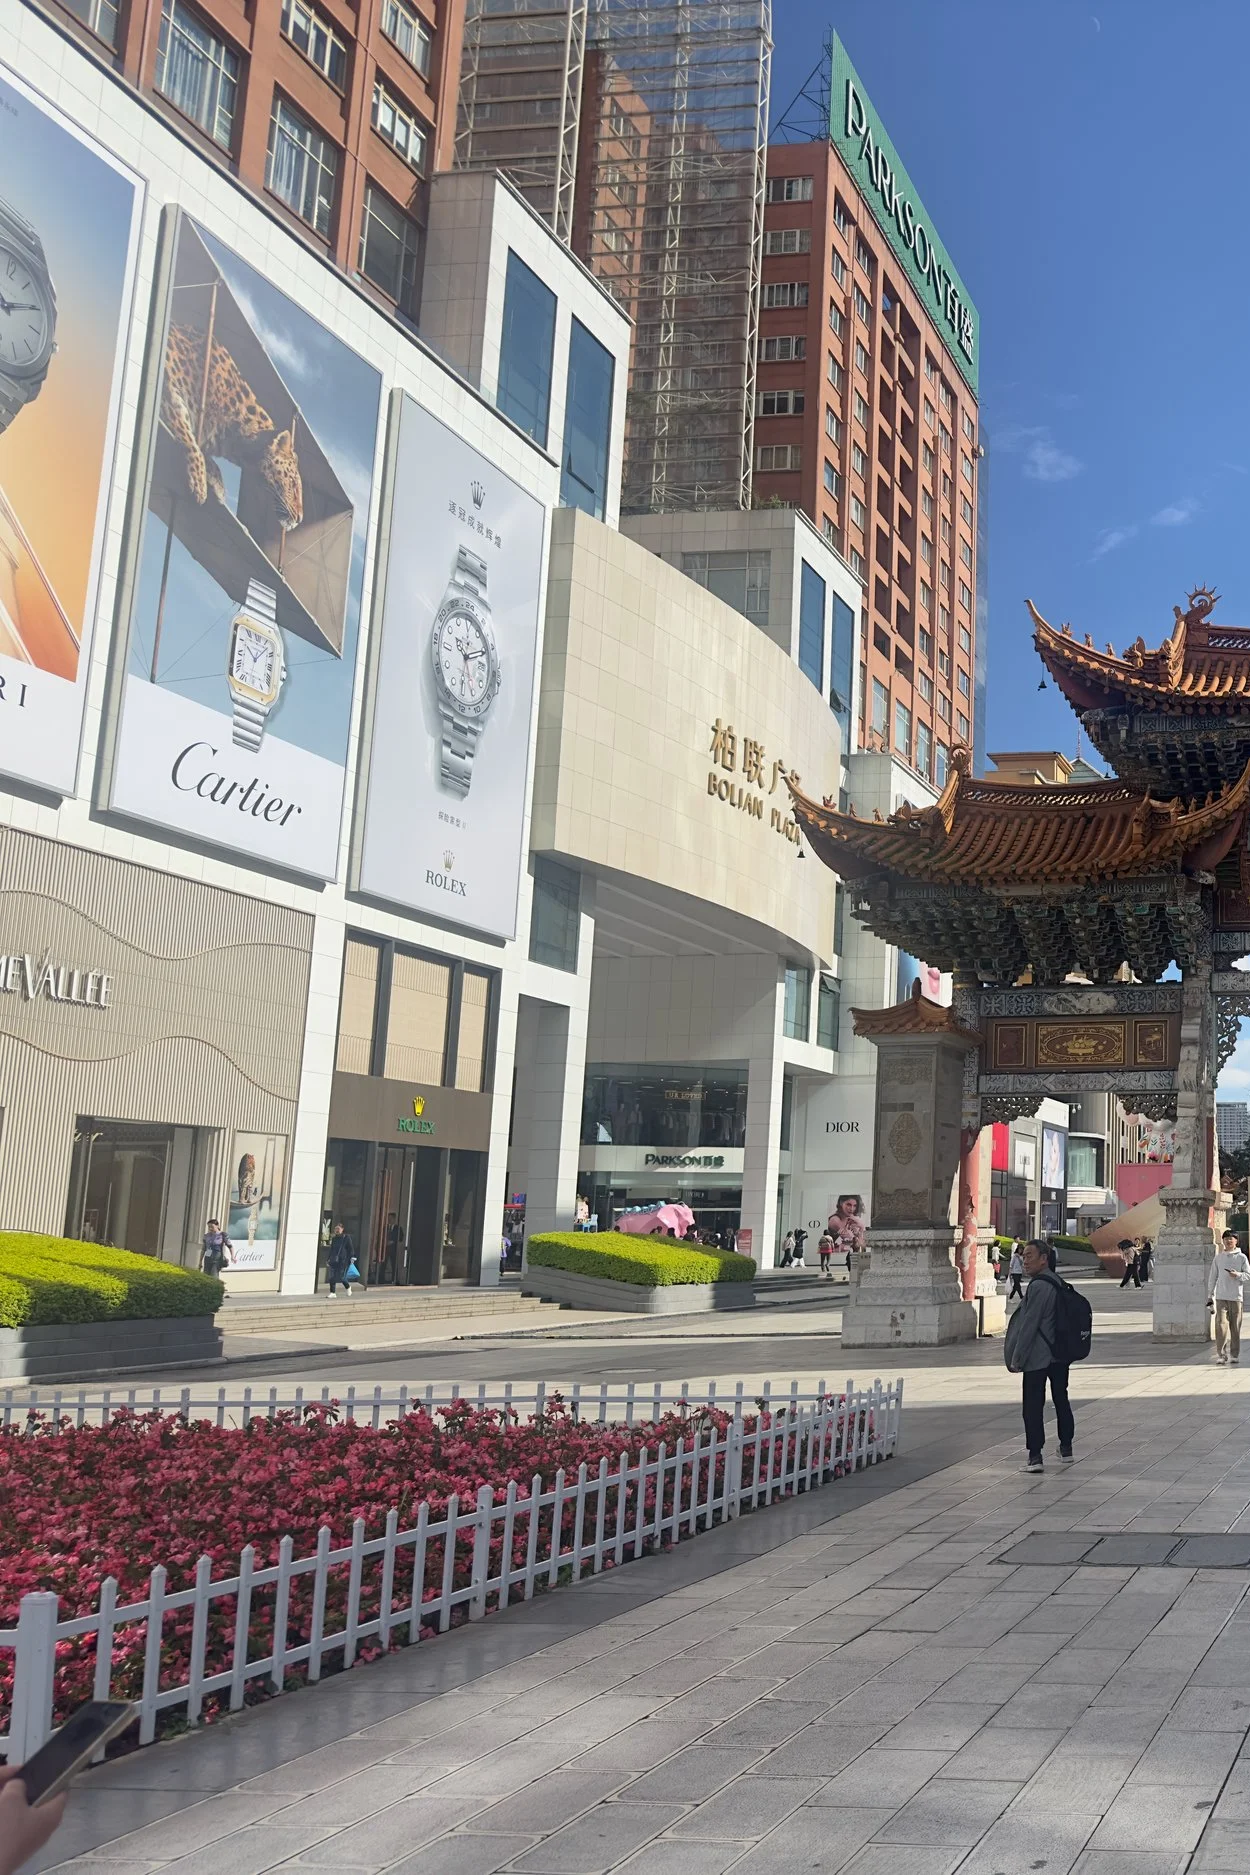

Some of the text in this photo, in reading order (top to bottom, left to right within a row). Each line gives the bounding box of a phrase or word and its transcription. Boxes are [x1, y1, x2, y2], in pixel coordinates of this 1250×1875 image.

[846, 79, 943, 306] PARKSON
[171, 741, 302, 826] Cartier
[707, 772, 801, 846] BOLIAN PLAZA
[425, 869, 467, 896] ROLEX
[397, 1119, 435, 1135] ROLEX
[826, 1122, 860, 1133] DIOR
[645, 1154, 701, 1166] PARKSON
